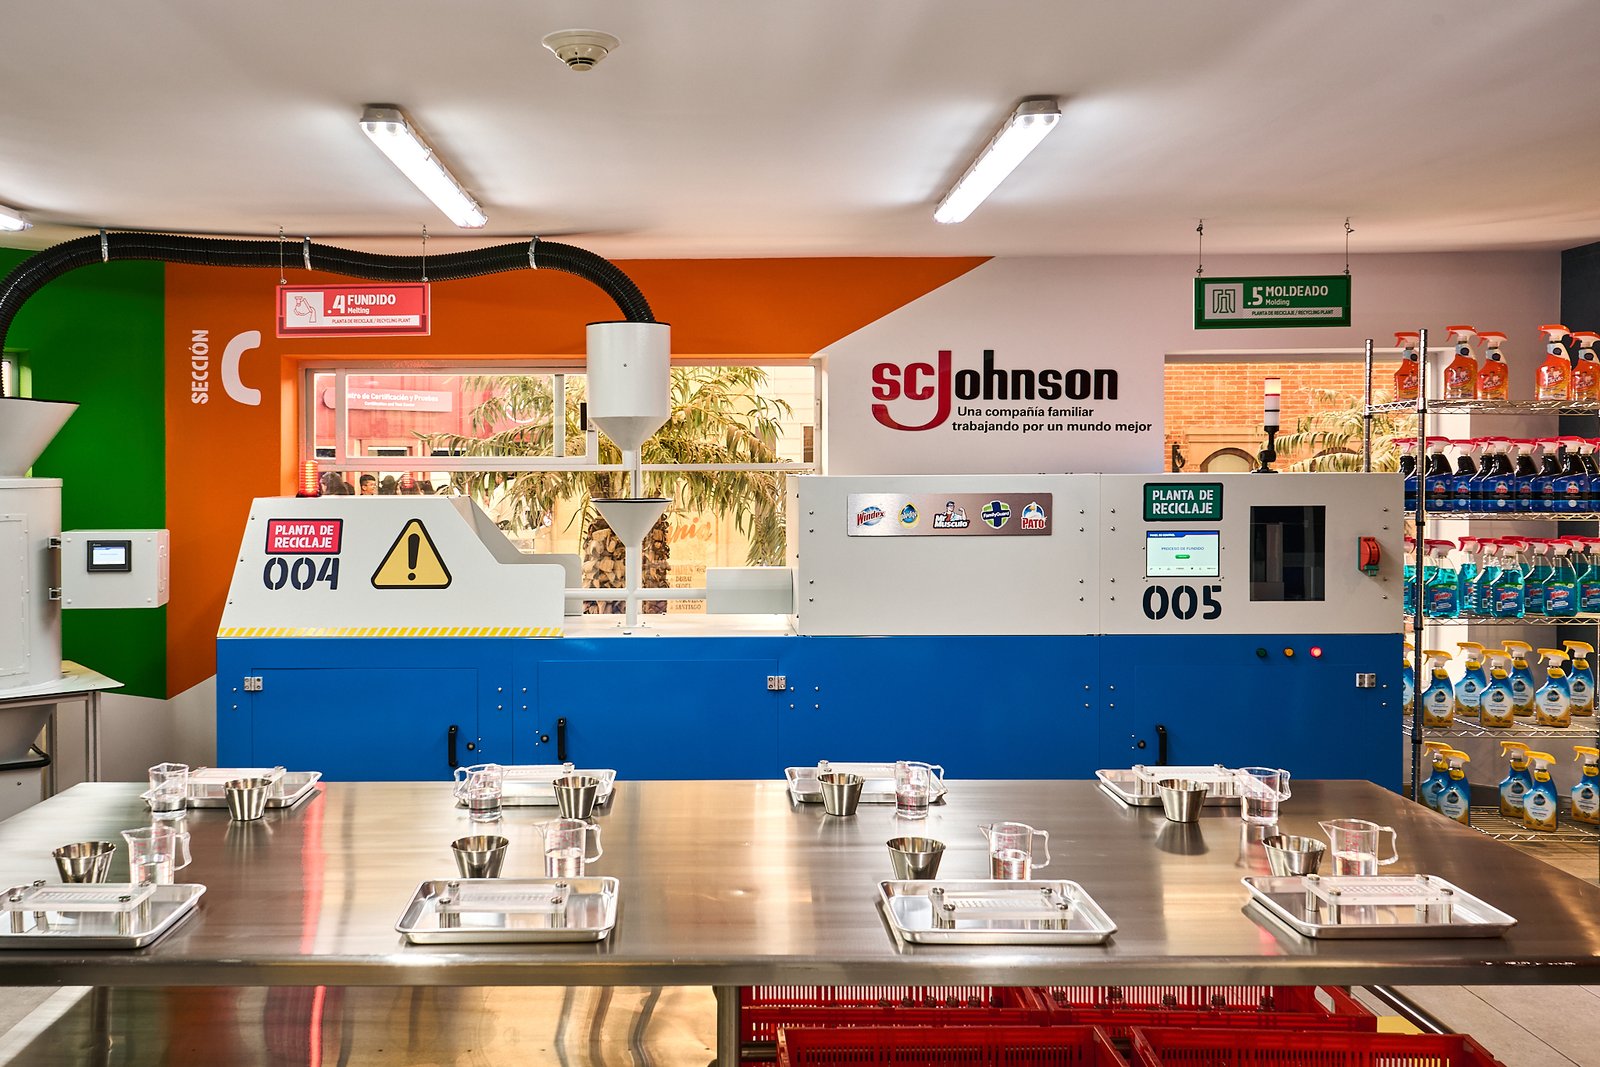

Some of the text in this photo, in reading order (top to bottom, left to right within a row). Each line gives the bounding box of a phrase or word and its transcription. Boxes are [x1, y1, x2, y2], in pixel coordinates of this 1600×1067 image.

[1266, 286, 1328, 296] MOLDEADO
[347, 294, 396, 305] FUNDIDO
[188, 330, 209, 404] SECCIÓN
[221, 330, 261, 406] C
[958, 406, 1094, 419] Una compañía familiar
[952, 421, 1019, 433] trabajando
[1023, 423, 1044, 433] por
[1067, 421, 1111, 431] mundo
[1115, 421, 1152, 434] mejor
[1152, 490, 1214, 500] PLANTA DE
[1152, 503, 1213, 514] RECICLAJE
[856, 510, 885, 526] Windex
[275, 525, 334, 535] PLANTA DE
[274, 537, 332, 548] RECICLAJE
[263, 557, 340, 590] 004
[1143, 585, 1222, 620] 005
